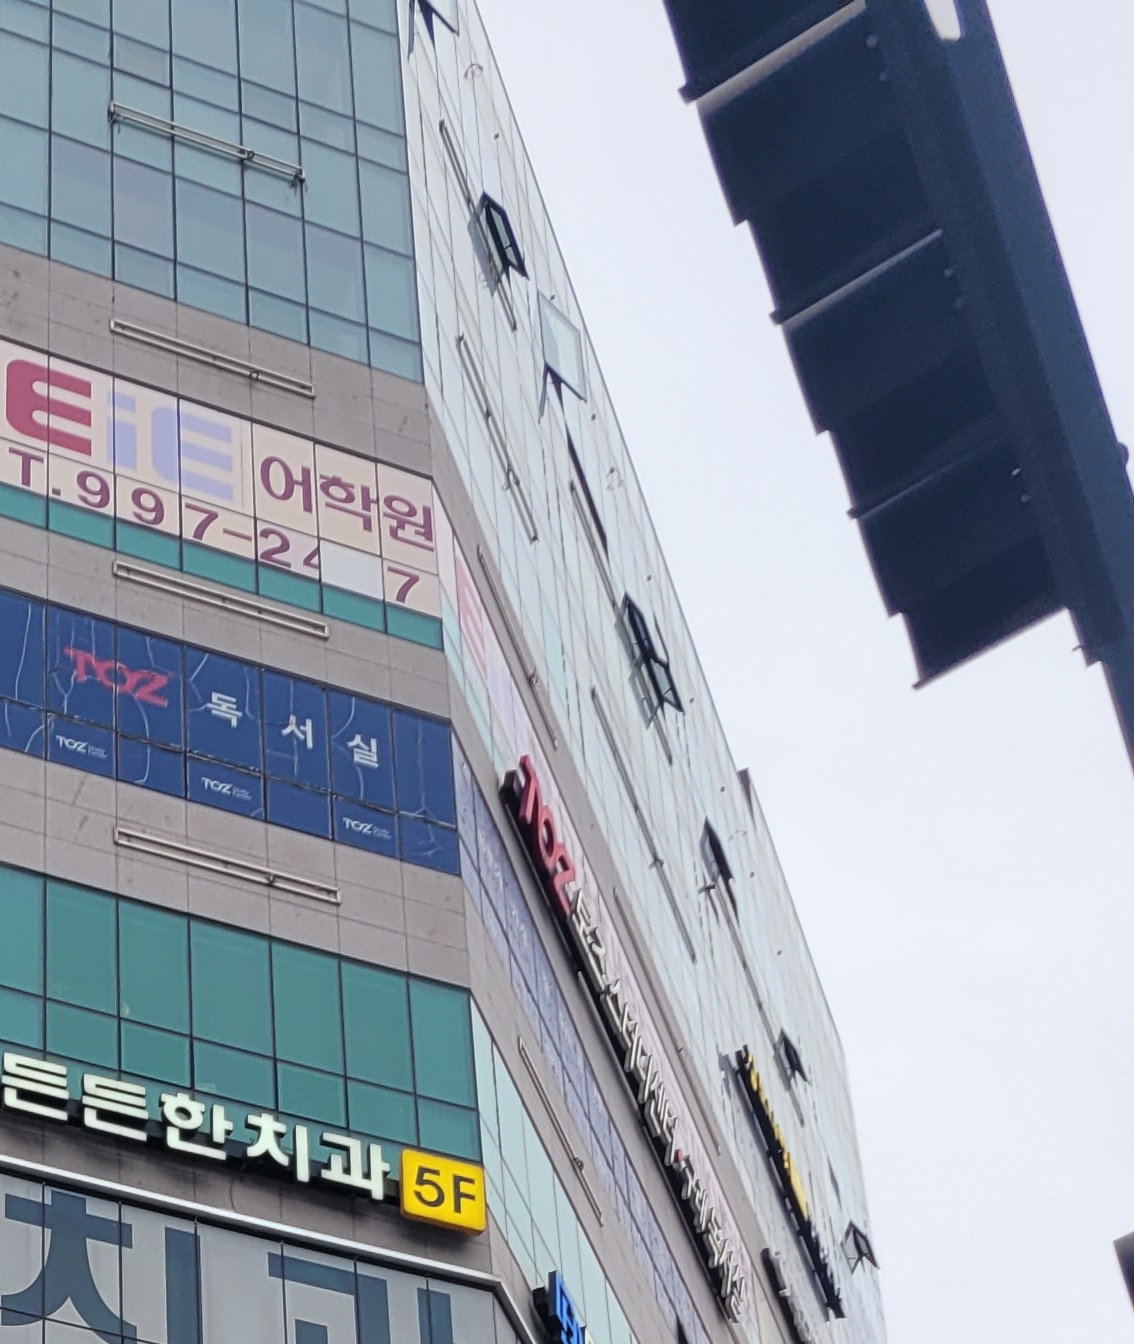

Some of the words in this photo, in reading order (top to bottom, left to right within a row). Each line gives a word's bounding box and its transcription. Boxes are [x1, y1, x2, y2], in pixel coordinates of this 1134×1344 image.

[261, 456, 435, 553] 어학원
[64, 646, 173, 708] TOZ
[55, 735, 88, 754] TOZ
[207, 691, 380, 769] 독서실
[201, 777, 233, 796] TOZ
[342, 818, 374, 835] TOZ
[1, 1052, 390, 1201] 든든한치과
[413, 1167, 478, 1217] 5F
